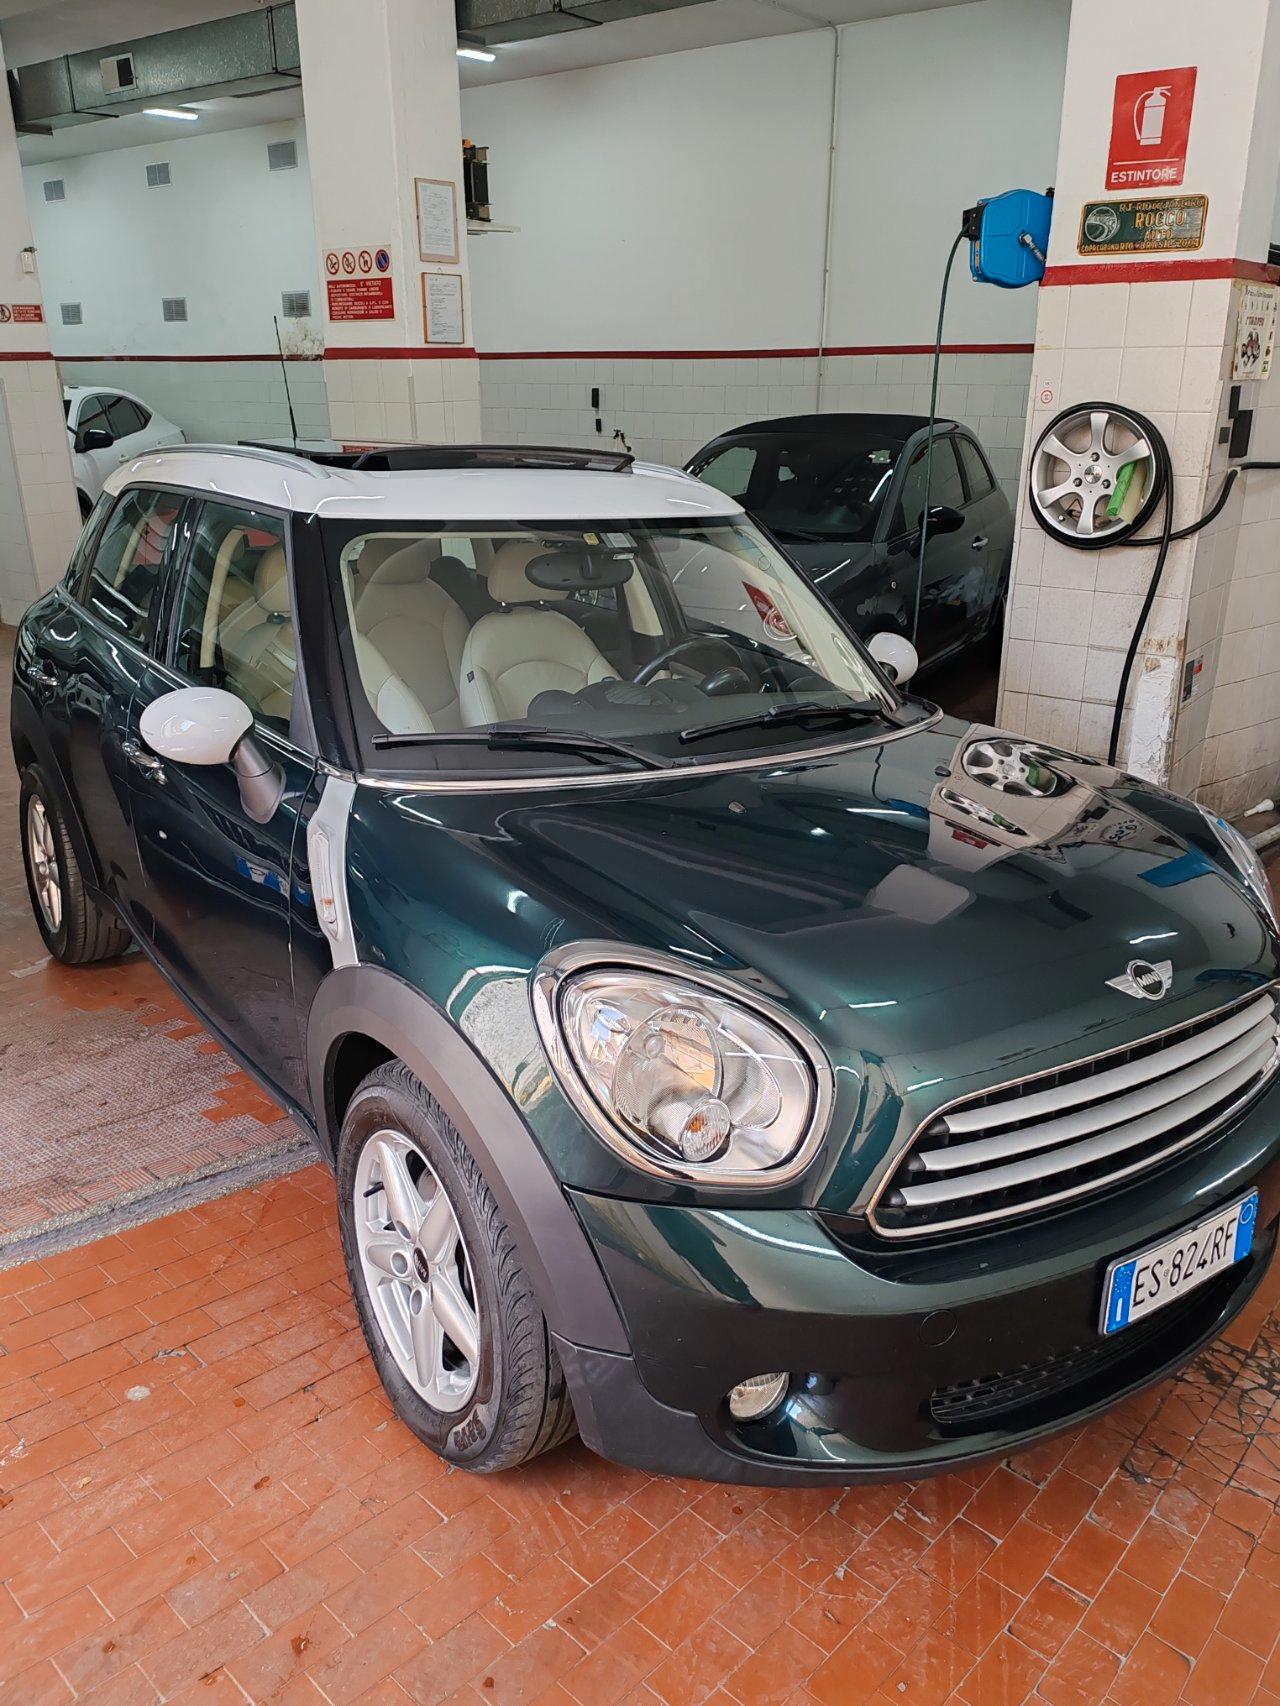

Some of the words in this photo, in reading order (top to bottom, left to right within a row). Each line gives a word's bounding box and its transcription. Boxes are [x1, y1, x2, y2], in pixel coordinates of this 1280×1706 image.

[1110, 167, 1178, 183] ESTINTORE
[1135, 210, 1185, 229] ROCCO
[1136, 970, 1161, 987] MINI
